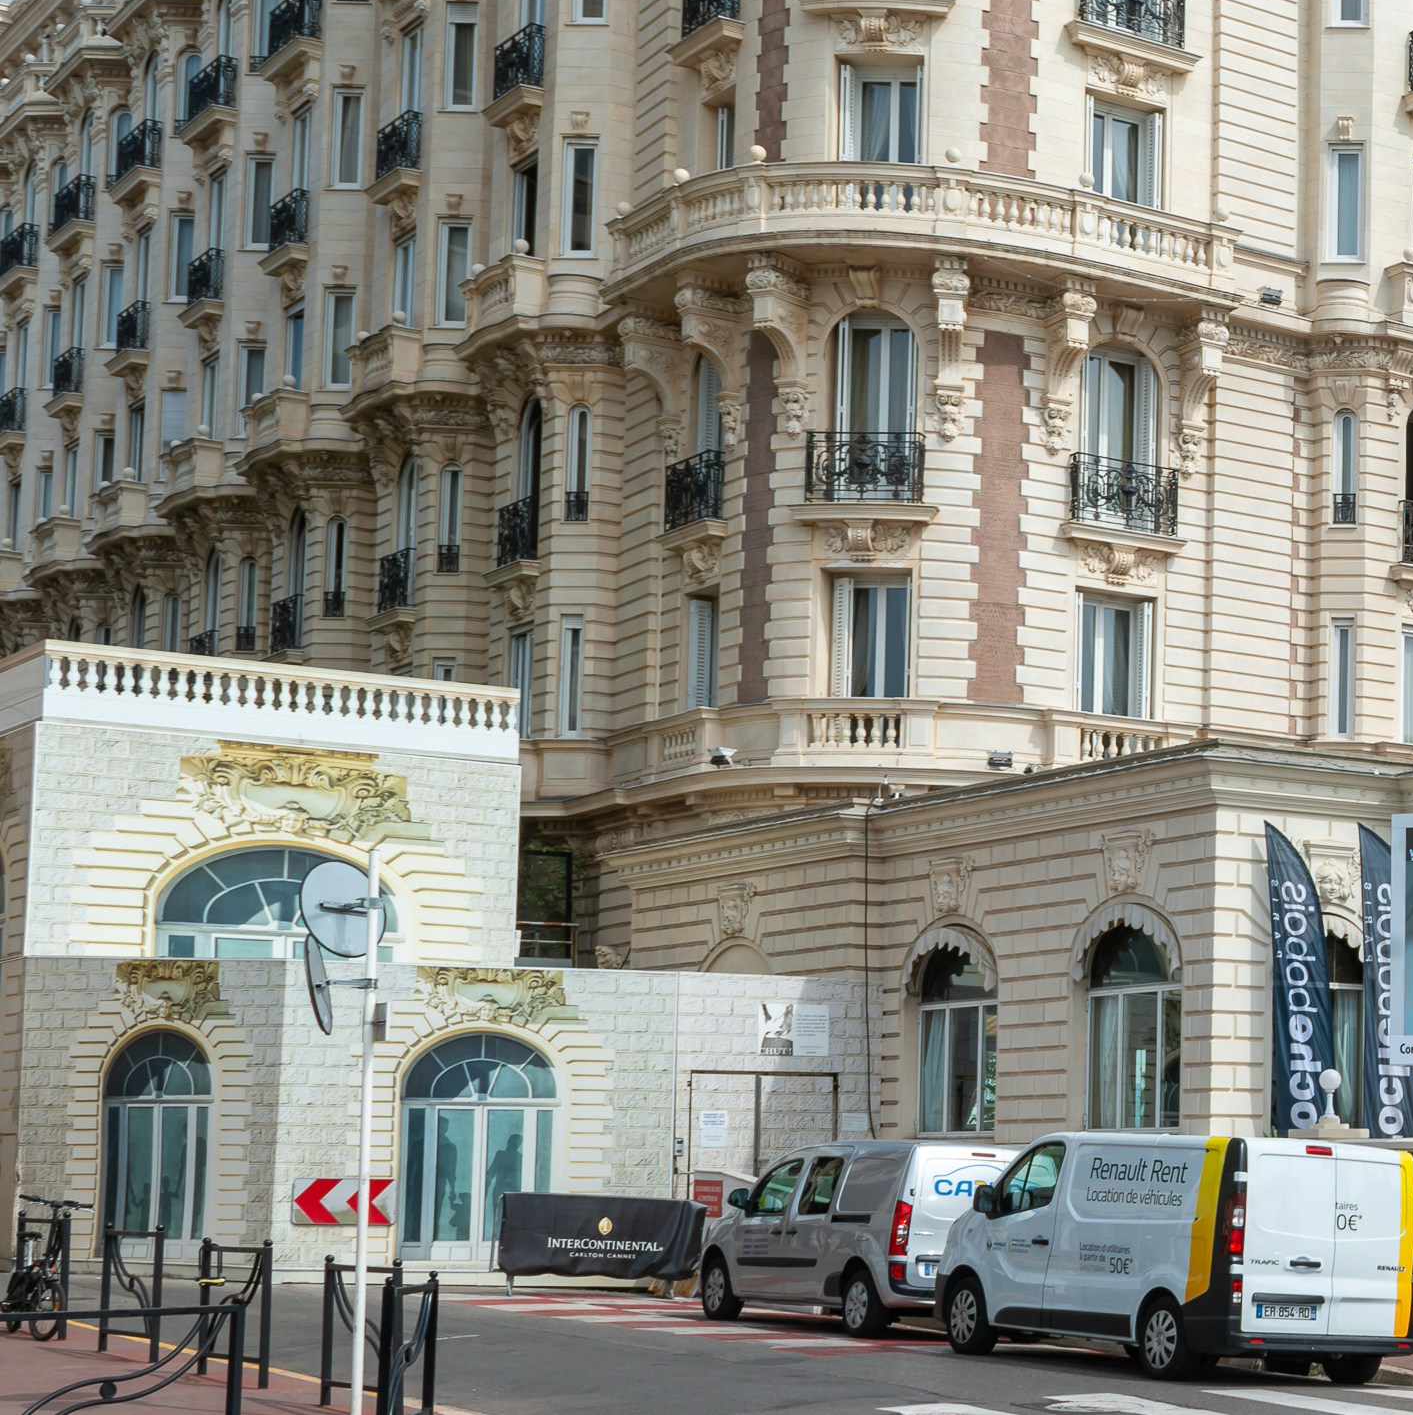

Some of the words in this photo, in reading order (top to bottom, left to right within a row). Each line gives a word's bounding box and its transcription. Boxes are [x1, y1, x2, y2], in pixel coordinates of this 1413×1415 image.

[1090, 1157, 1148, 1181] Renault
[1150, 1159, 1188, 1183] Rent
[1086, 1186, 1124, 1203] Location
[1126, 1188, 1138, 1204] de
[1139, 1188, 1182, 1206] véhicules
[1335, 1201, 1358, 1211] taires
[1080, 1242, 1101, 1252] Location
[569, 1251, 604, 1259] CARLTON
[606, 1252, 637, 1260] CANNES
